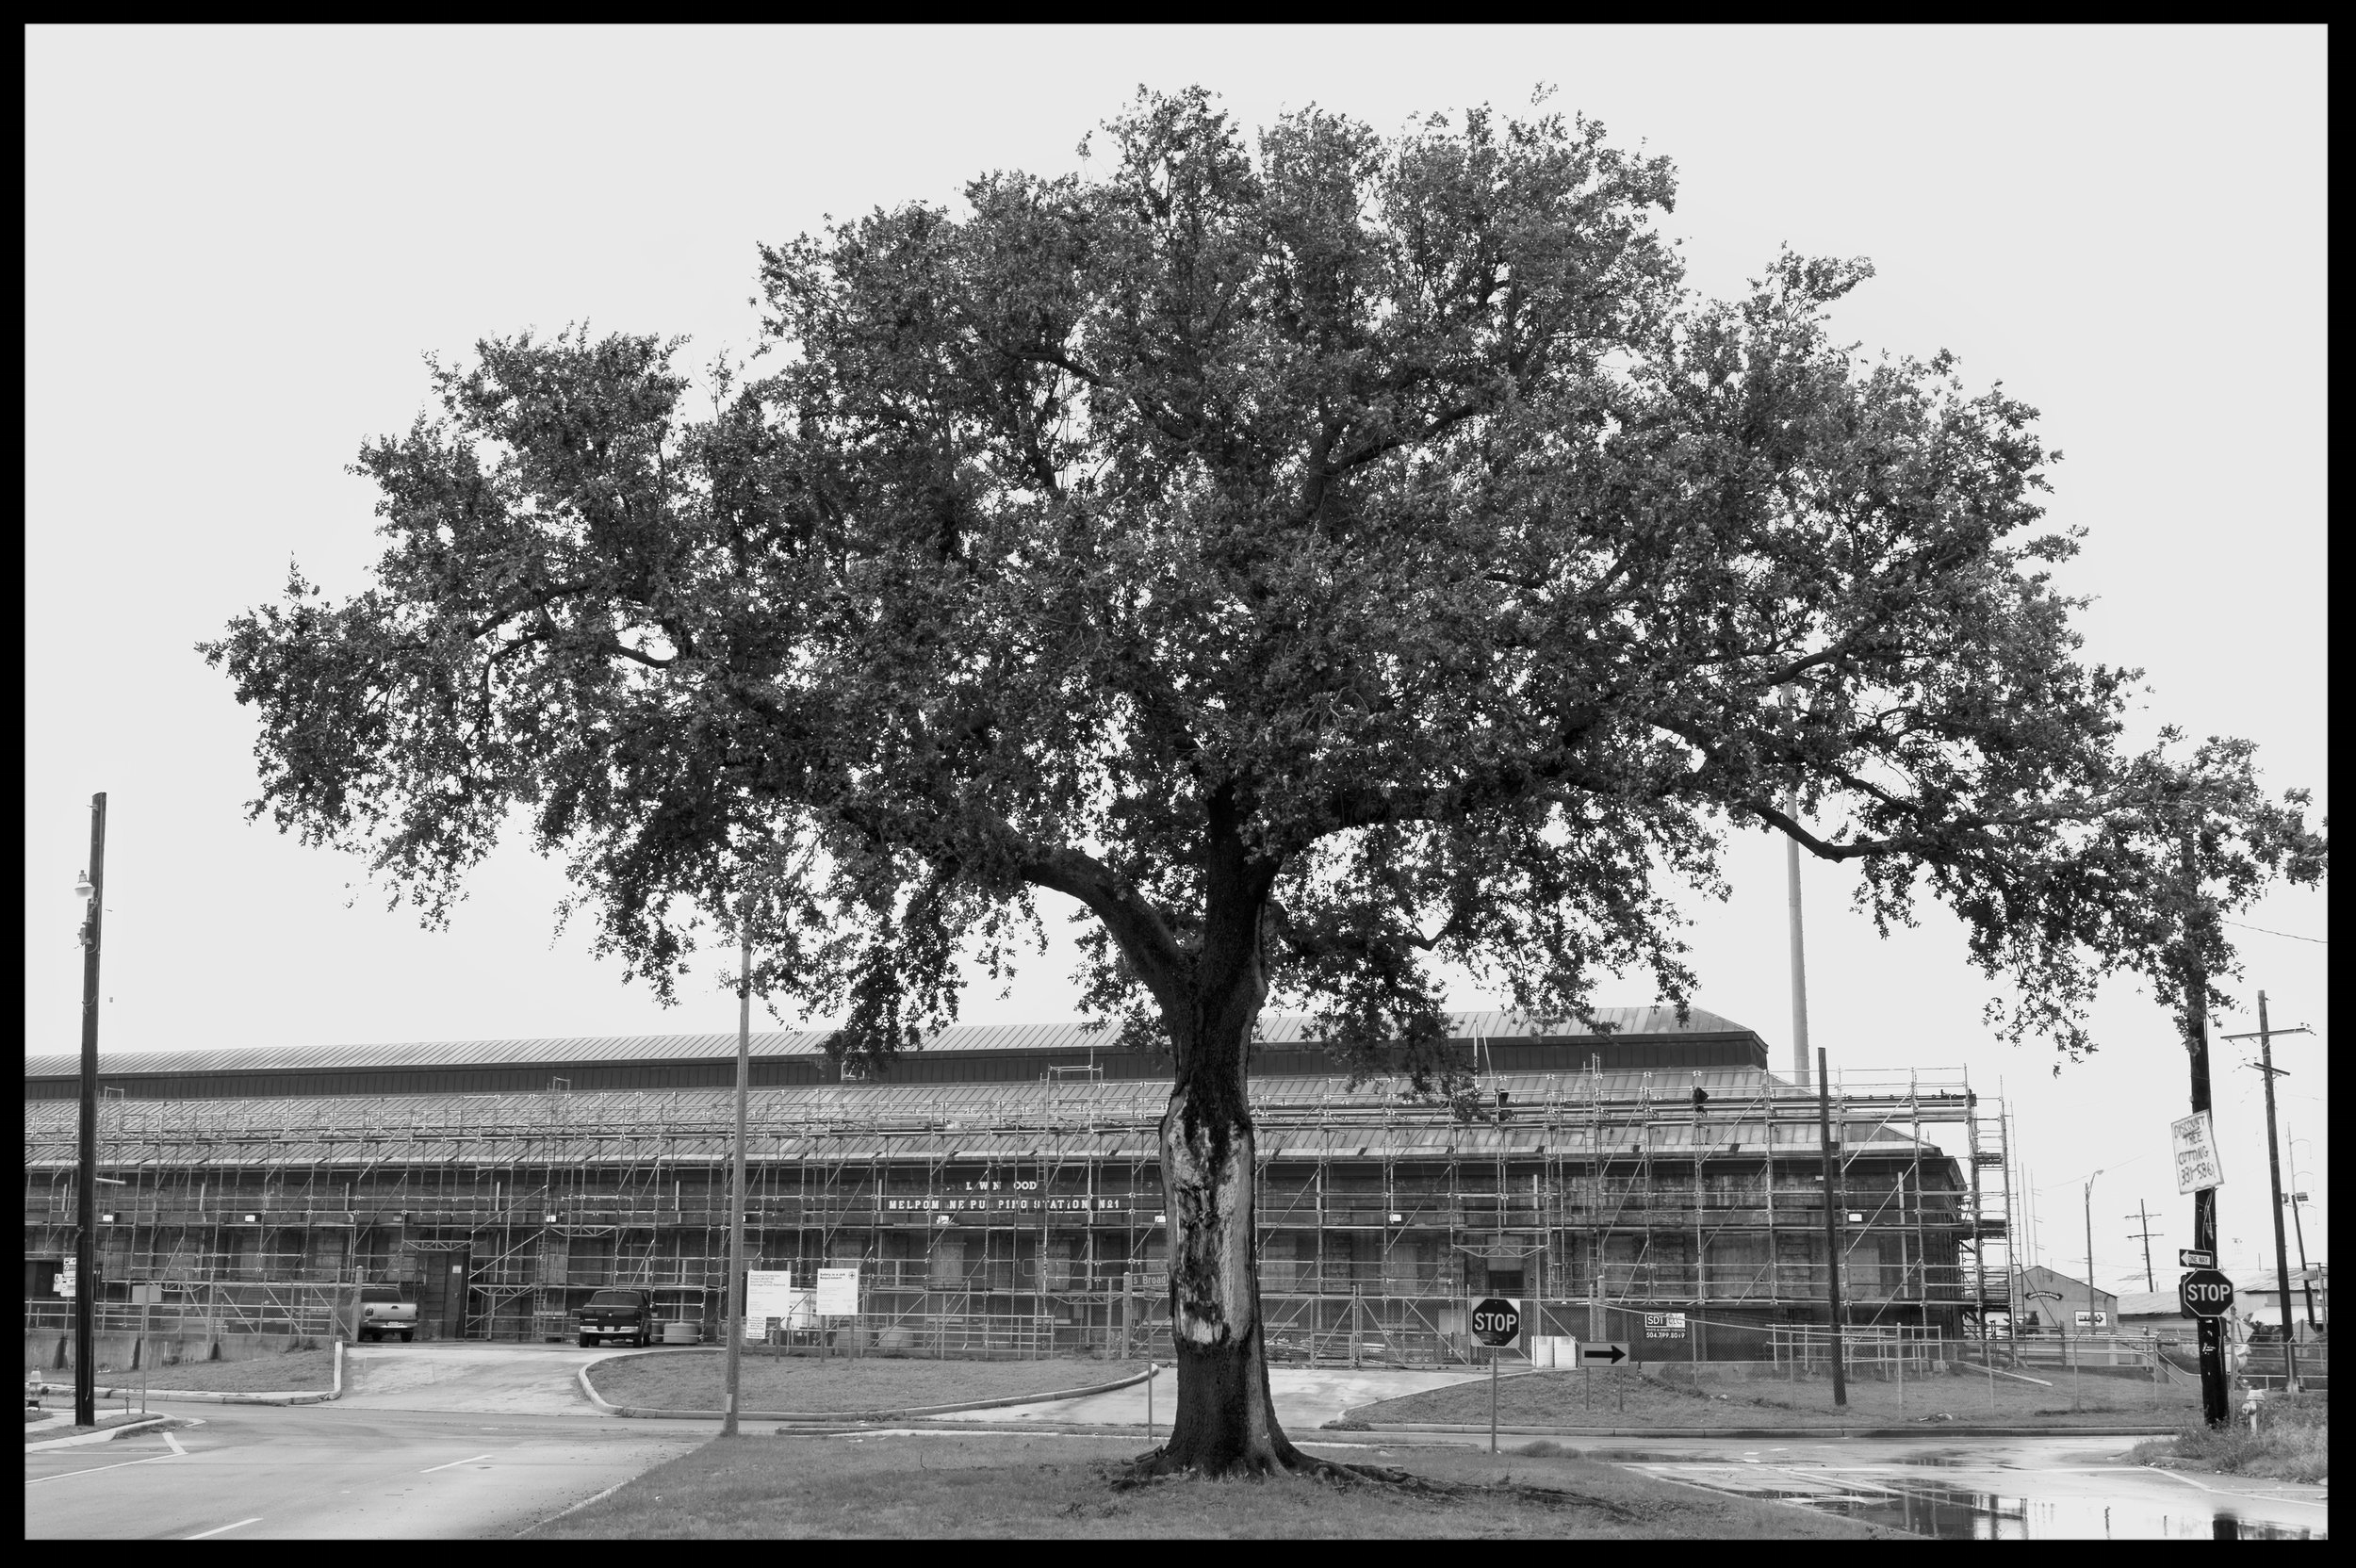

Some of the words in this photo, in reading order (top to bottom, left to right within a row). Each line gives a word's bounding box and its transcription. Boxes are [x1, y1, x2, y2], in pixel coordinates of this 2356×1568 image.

[2173, 1115, 2205, 1138] DISCOUNT
[2184, 1130, 2203, 1146] TREE
[2177, 1145, 2209, 1166] CUTTING
[889, 1200, 965, 1210] MELPOMNE
[1033, 1200, 1088, 1209] STATION
[1142, 1275, 1167, 1284] Broad
[2187, 1283, 2231, 1301] STOP
[1474, 1312, 1517, 1332] STOP
